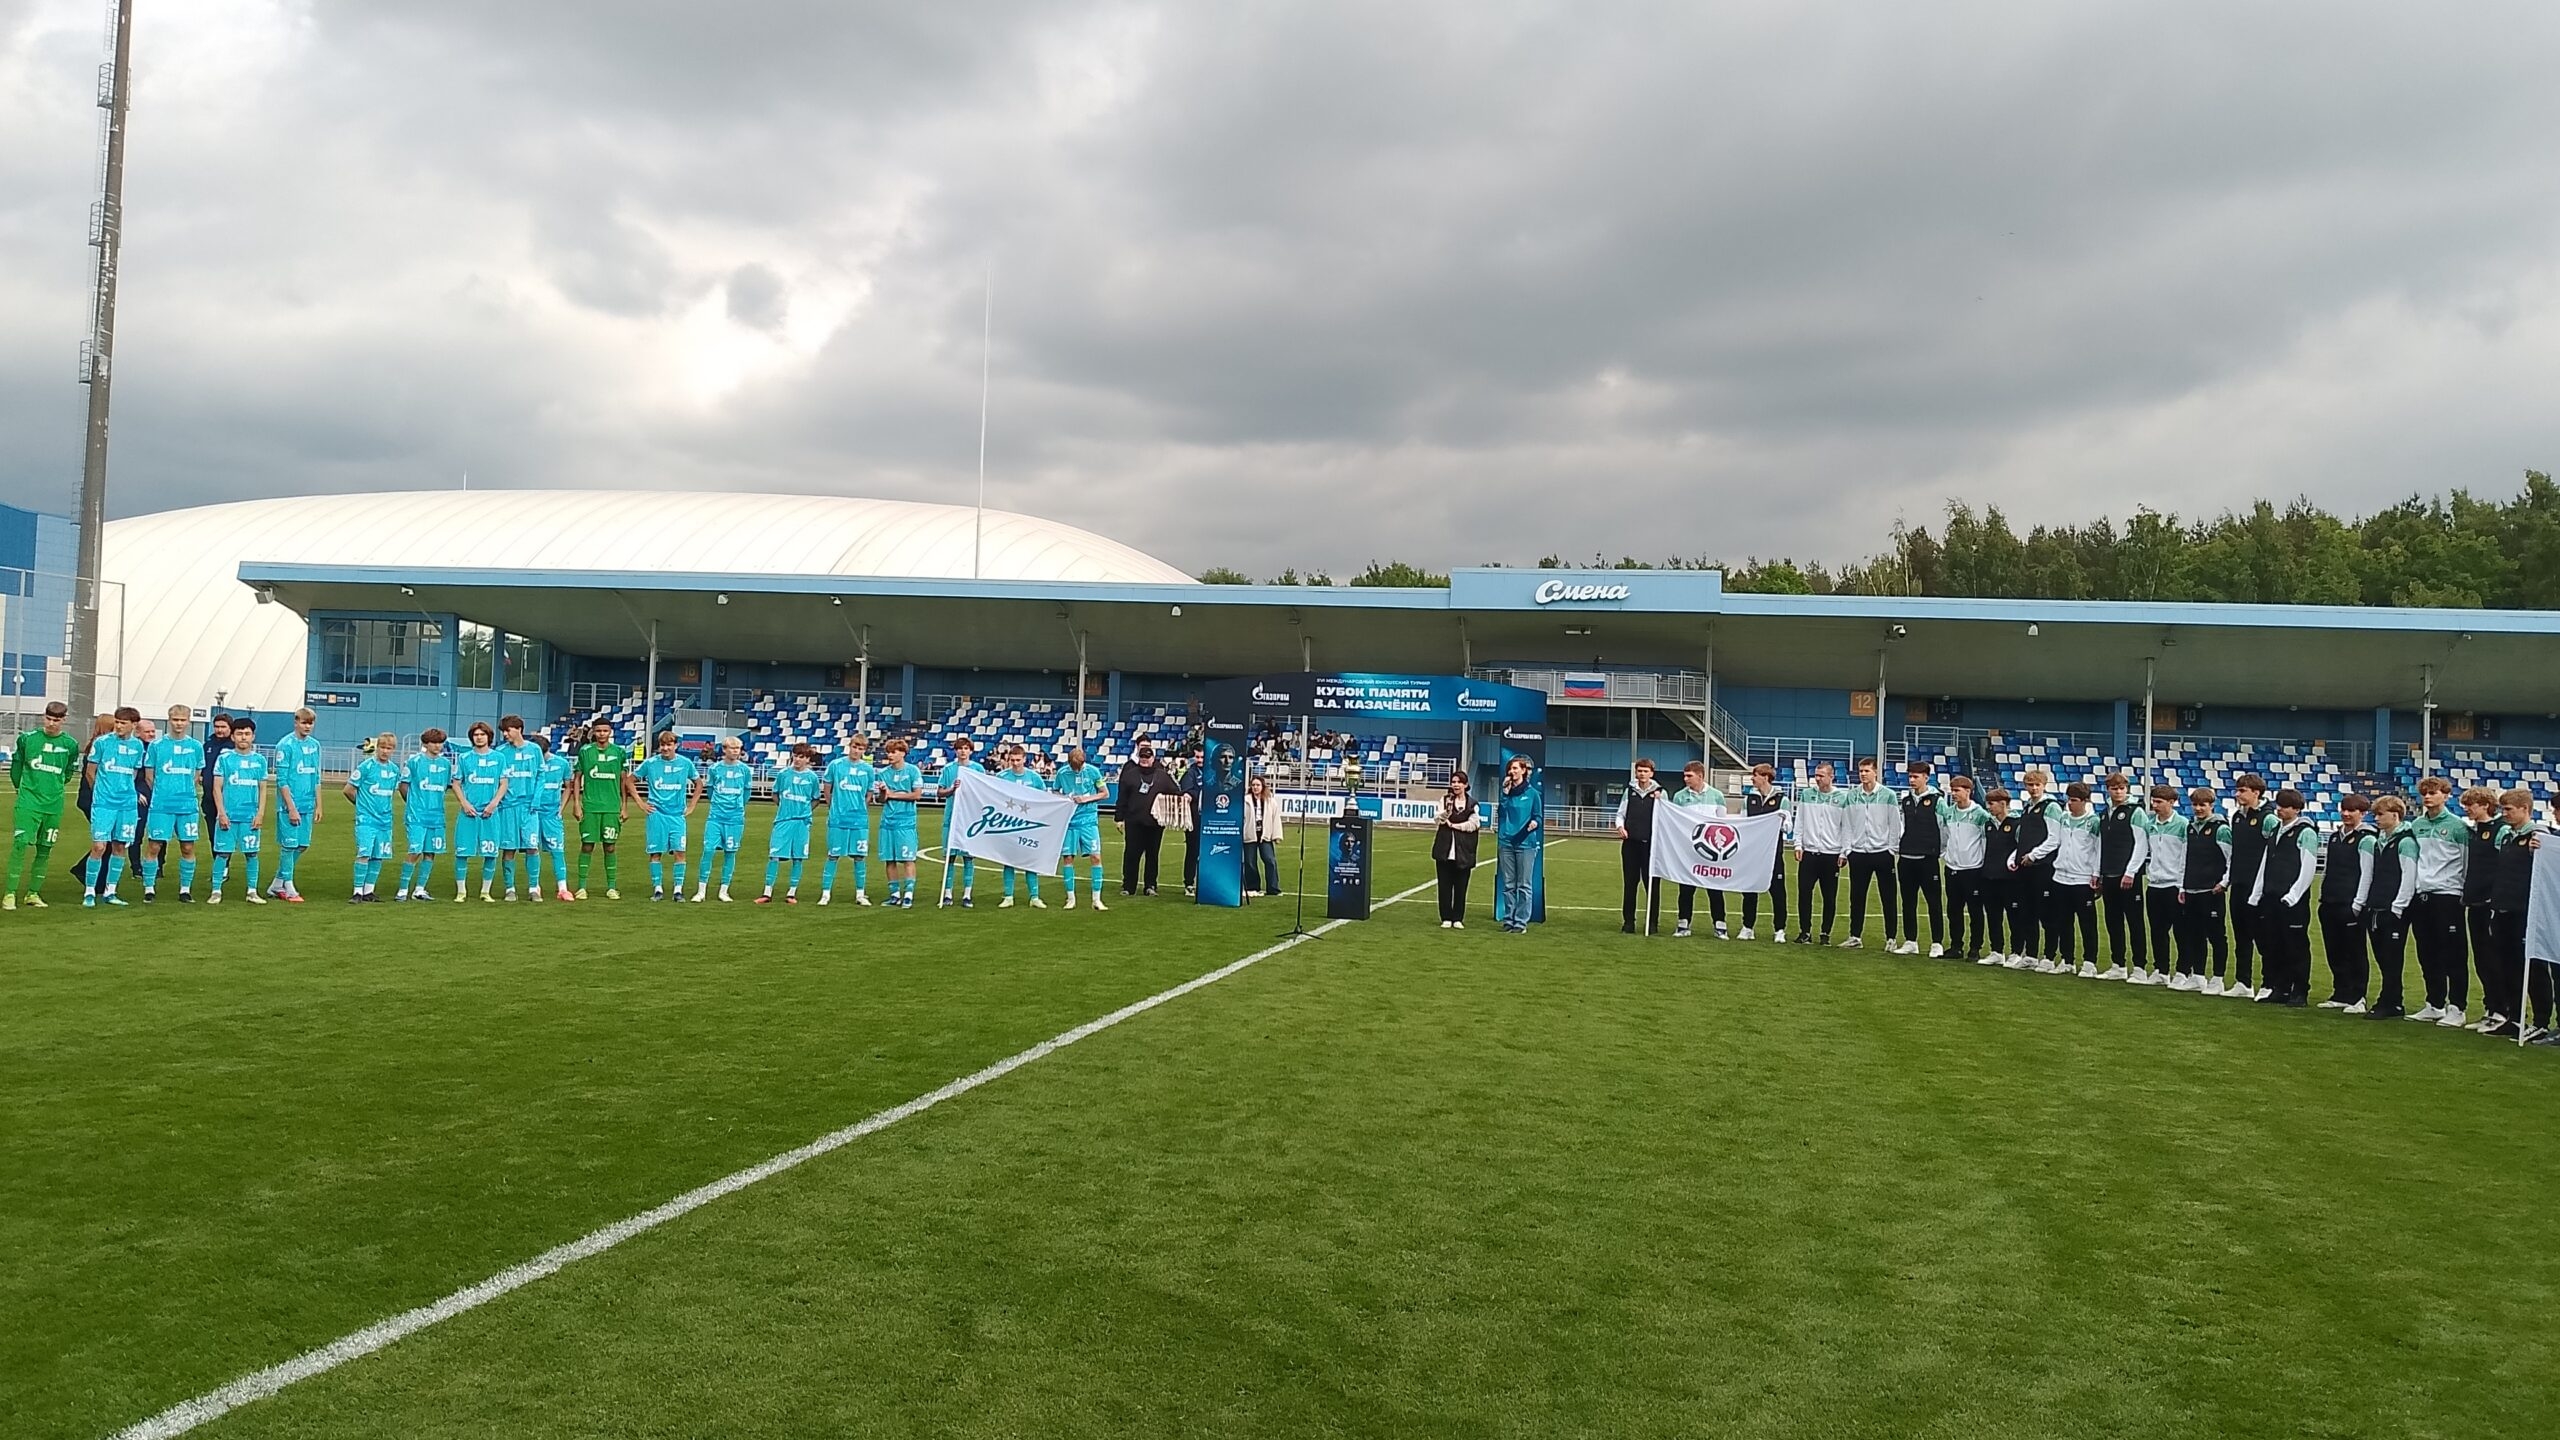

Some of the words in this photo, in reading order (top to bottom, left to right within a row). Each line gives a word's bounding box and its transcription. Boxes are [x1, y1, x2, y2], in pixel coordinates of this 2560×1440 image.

[1535, 580, 1631, 603] Смена
[1316, 686, 1365, 697] КУБОК
[1369, 688, 1429, 699] ПАМЯТИ
[1313, 698, 1341, 708] В.А.
[1344, 699, 1431, 711] КАЗАЧЁНКА
[1856, 695, 1871, 709] 12
[2182, 710, 2196, 721] 10
[1391, 803, 1438, 819] ГАЗПРО
[47, 828, 59, 842] 16
[603, 827, 615, 839] 30
[1018, 836, 1040, 848] 1925
